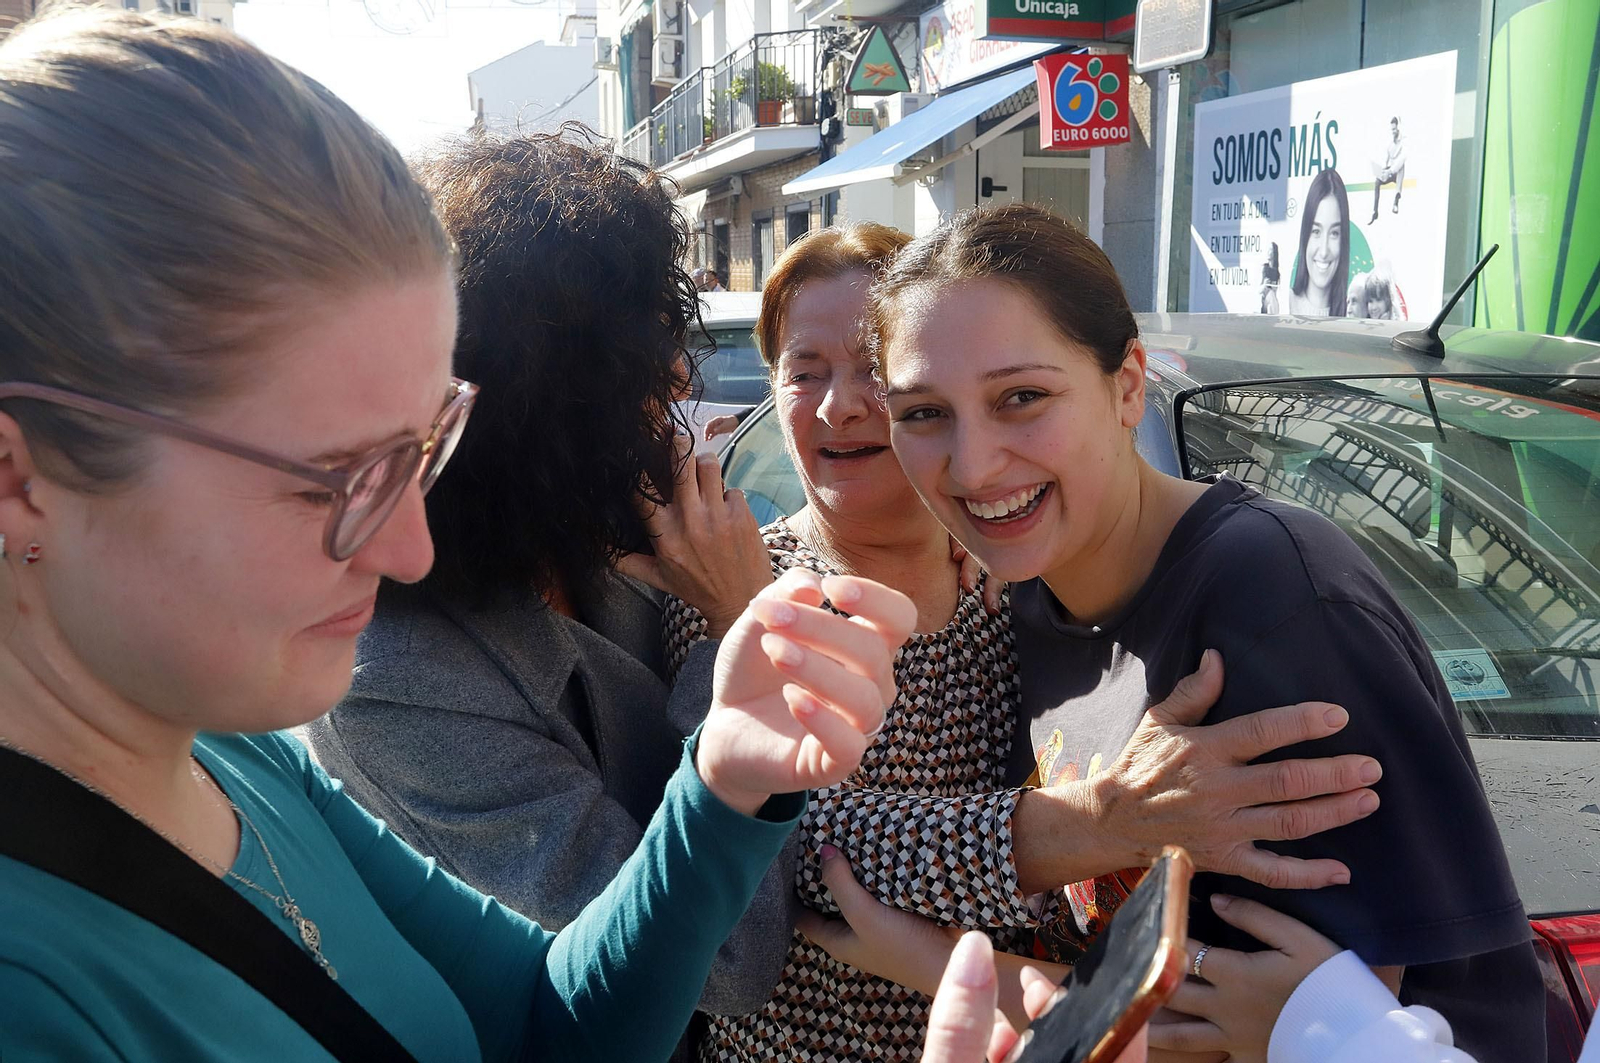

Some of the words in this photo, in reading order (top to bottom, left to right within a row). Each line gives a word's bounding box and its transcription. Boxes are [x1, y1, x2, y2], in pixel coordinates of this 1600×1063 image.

[1015, 0, 1079, 19] Unicaja
[1053, 128, 1089, 142] EURO
[1092, 126, 1129, 140] 6000
[1213, 127, 1282, 185] SOMOS
[1288, 111, 1338, 178] MÁS
[1211, 203, 1222, 221] EN
[1223, 202, 1233, 221] TU
[1233, 198, 1246, 220] DÍA
[1247, 201, 1253, 219] A
[1255, 196, 1270, 219] DÍA.
[1211, 235, 1220, 253] EN
[1222, 235, 1232, 253] TU
[1232, 235, 1262, 253] TIEMPO.
[1209, 268, 1219, 286] EN
[1221, 268, 1231, 286] TU
